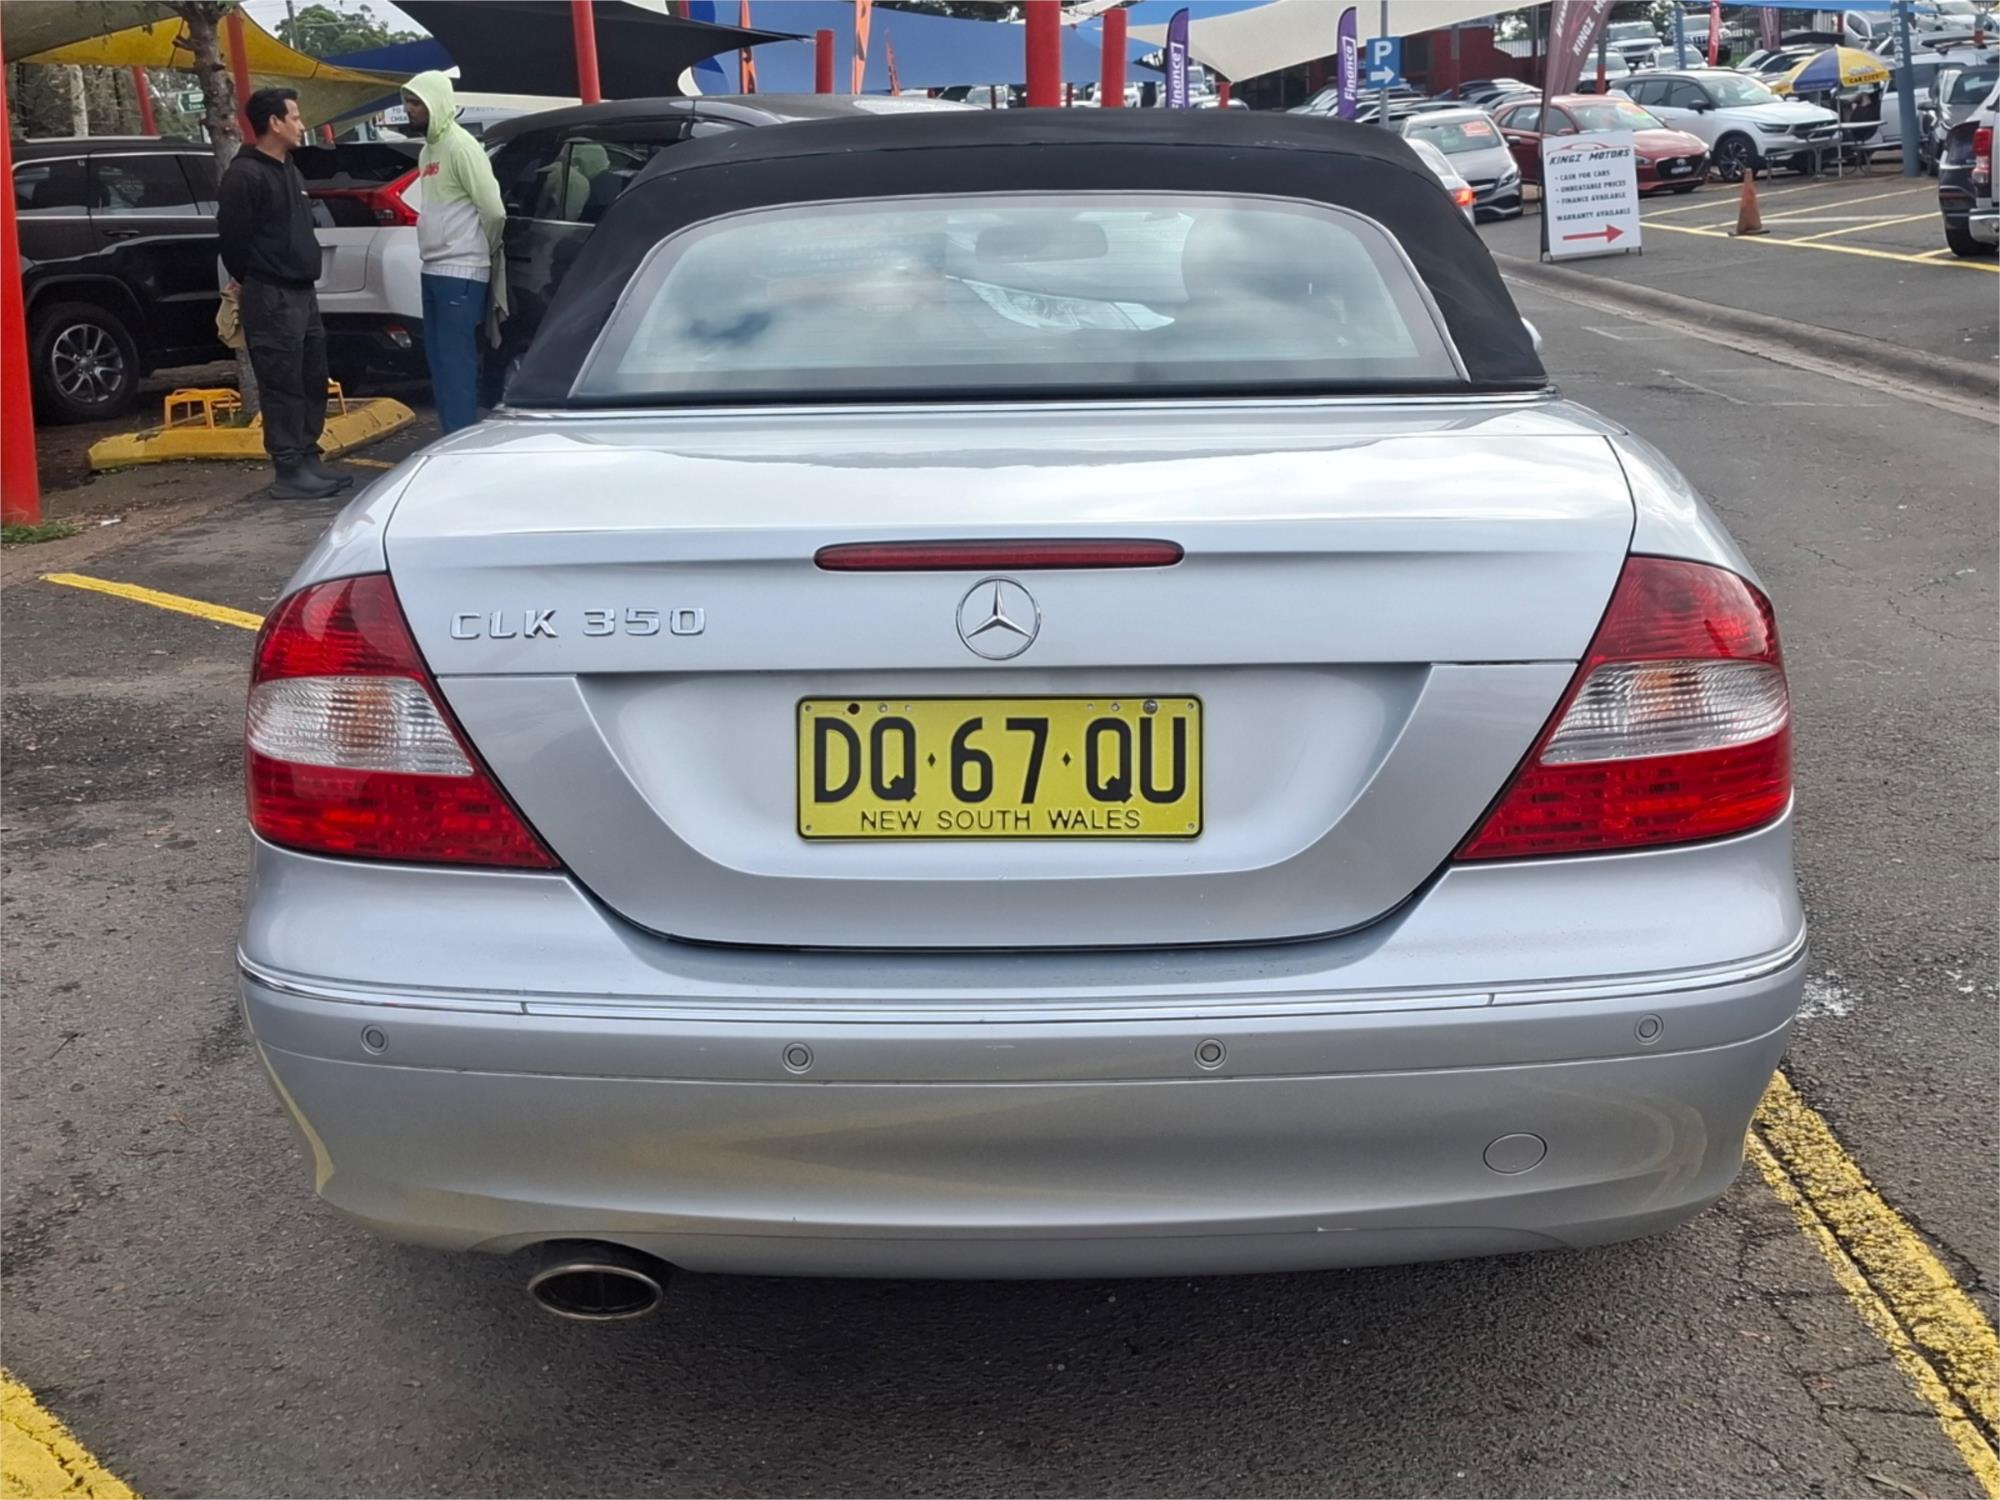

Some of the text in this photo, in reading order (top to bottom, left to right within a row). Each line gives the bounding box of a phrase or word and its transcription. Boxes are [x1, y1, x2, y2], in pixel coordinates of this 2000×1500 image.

[1572, 16, 1595, 56] KINGZ
[1374, 41, 1393, 65] P
[1344, 45, 1356, 100] Finance
[1549, 148, 1631, 166] KINGZ MOTORS
[1593, 169, 1610, 178] CARS
[1560, 180, 1626, 193] UNBEATABLE PRICES
[1561, 192, 1626, 204] FINANCE AVAILABLE
[1557, 208, 1631, 221] WARRANTY AVAILABLE
[451, 607, 705, 640] CLK 350
[860, 809, 1142, 831] NEW SOUTH WALES
